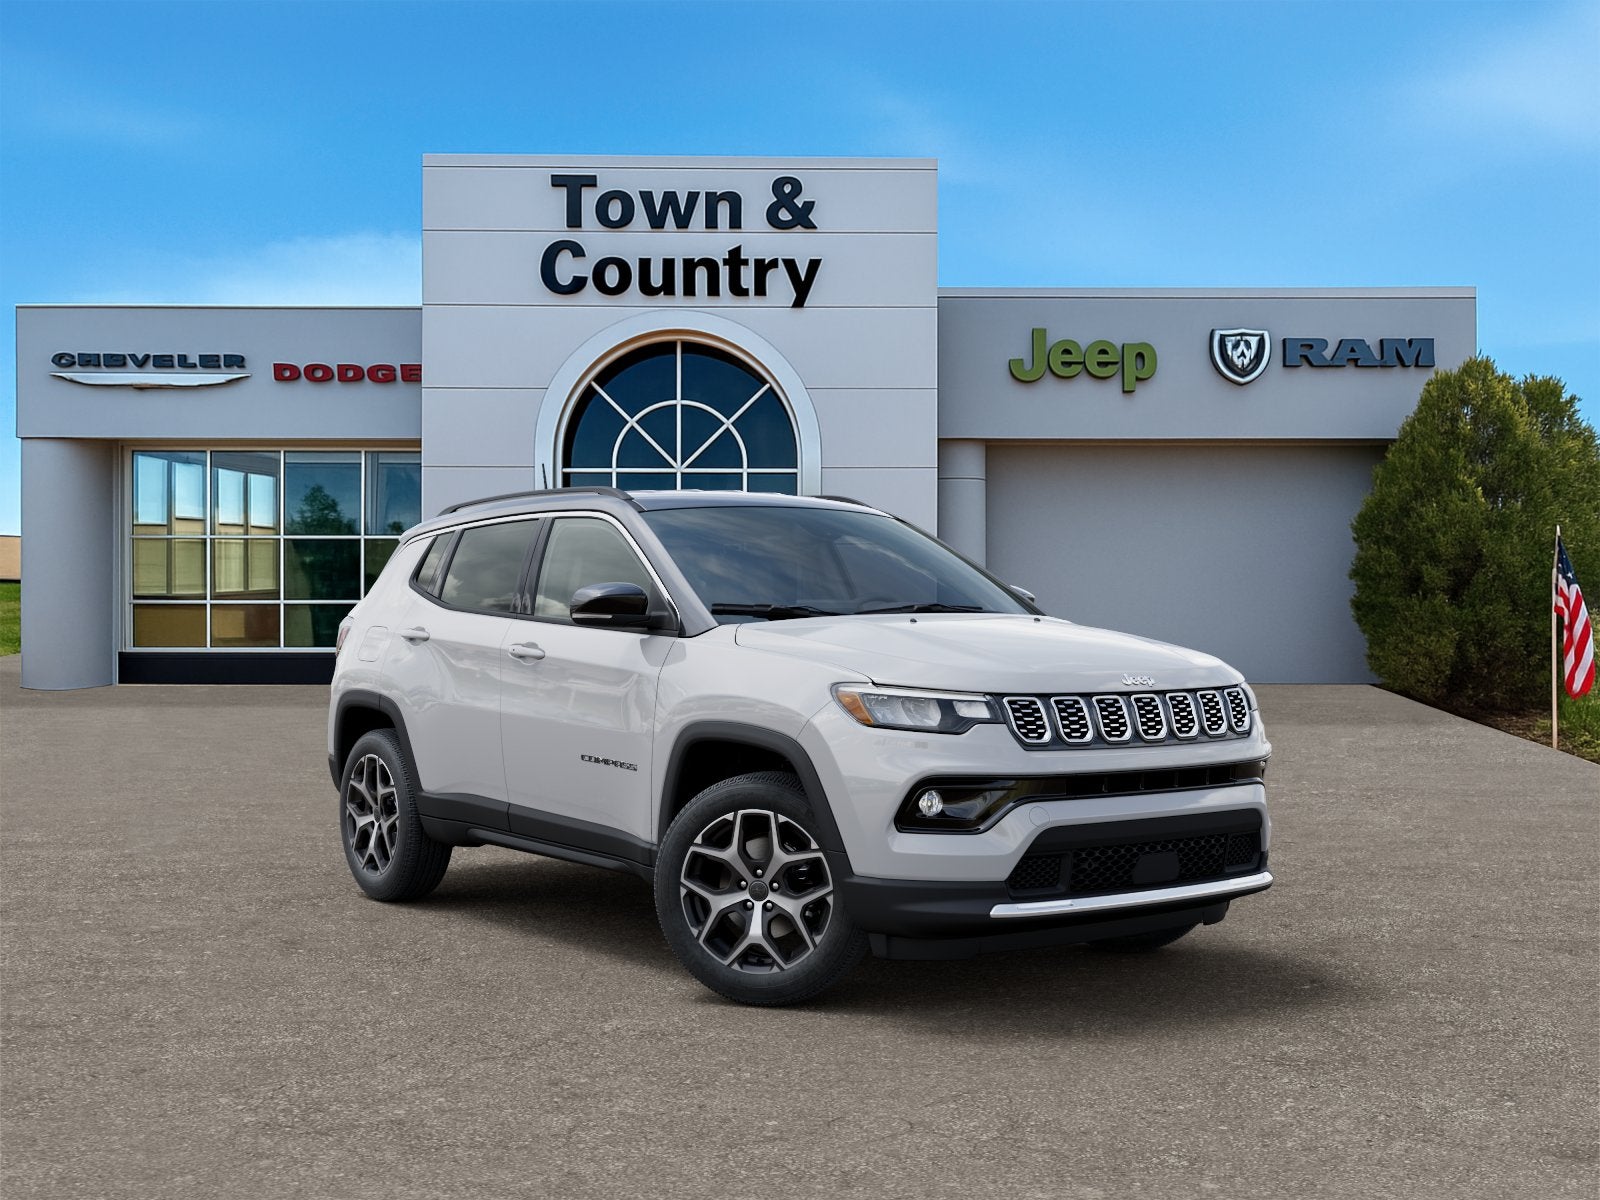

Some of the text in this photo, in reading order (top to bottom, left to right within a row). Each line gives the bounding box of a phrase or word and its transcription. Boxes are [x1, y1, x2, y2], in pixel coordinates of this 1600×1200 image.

[550, 174, 818, 231] Town &
[540, 239, 823, 309] Country
[272, 363, 422, 384] DODGE
[1009, 328, 1158, 393] Jeep
[1283, 337, 1436, 368] RAM
[1121, 673, 1156, 688] Jeep
